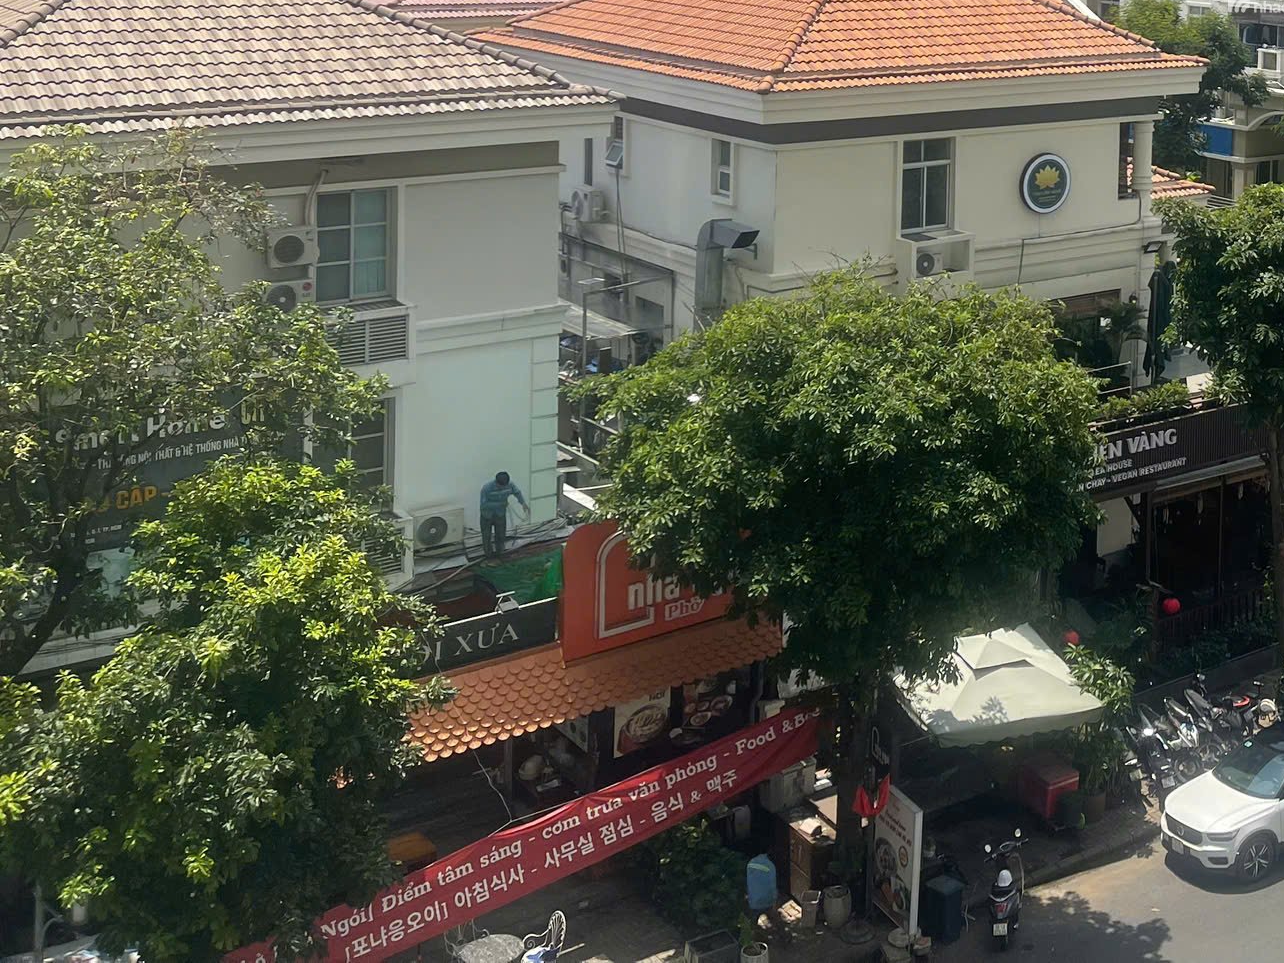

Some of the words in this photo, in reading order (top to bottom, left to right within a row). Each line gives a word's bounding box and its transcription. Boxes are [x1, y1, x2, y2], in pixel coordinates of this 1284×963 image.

[196, 439, 221, 454] THỐNG
[1127, 428, 1178, 454] VÀNG
[1086, 478, 1106, 490] CHAY
[1112, 469, 1138, 483] VEGAN
[1139, 457, 1187, 477] RESTAURANT
[1107, 458, 1133, 472] HOUSE
[454, 622, 520, 656] XƯA
[437, 861, 474, 886] tâm
[479, 837, 523, 868] sáng
[542, 817, 581, 840] cơm
[586, 796, 623, 821] trưa
[628, 779, 661, 803] văn
[736, 726, 777, 755] Food
[455, 863, 525, 909] 아침식사
[544, 833, 595, 870] 사무실
[600, 815, 634, 846] 점심
[650, 794, 684, 823] 음식
[690, 791, 702, 803] &
[706, 769, 738, 794] 맥주
